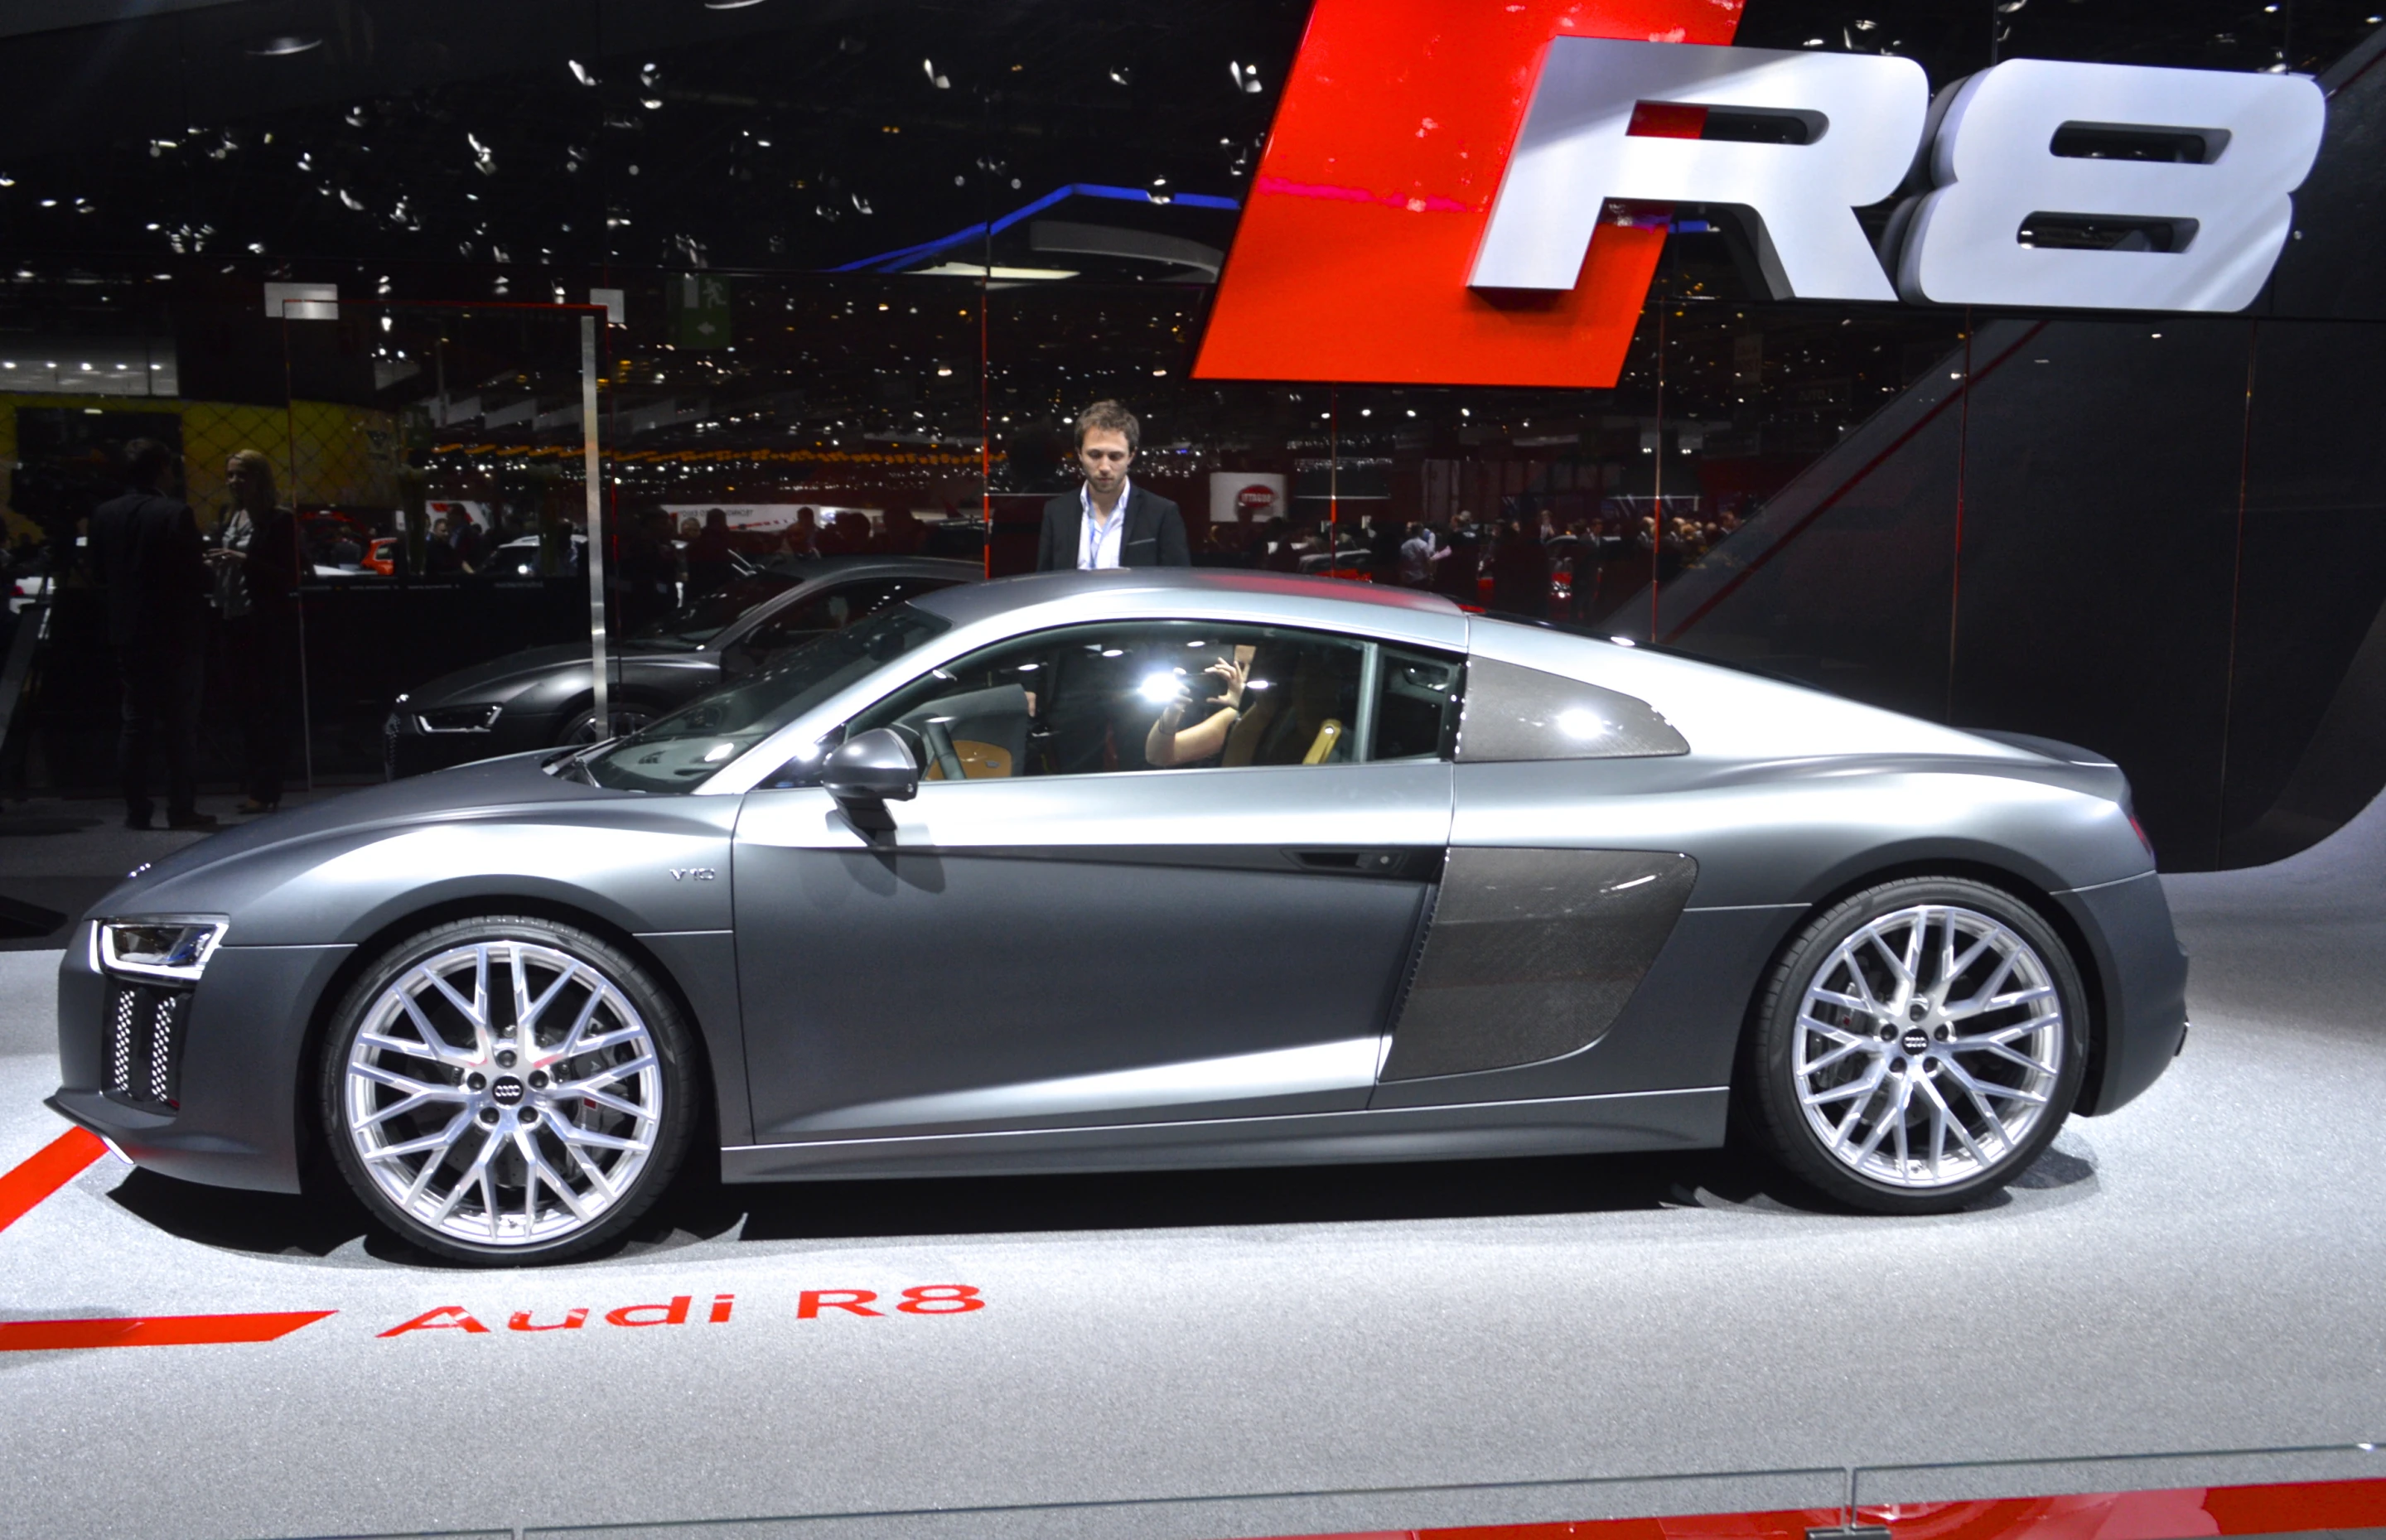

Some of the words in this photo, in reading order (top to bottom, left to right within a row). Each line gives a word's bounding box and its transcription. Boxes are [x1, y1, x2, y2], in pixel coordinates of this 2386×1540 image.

[1466, 35, 2326, 313] R8
[669, 867, 715, 881] V10
[374, 1294, 735, 1338] Audi
[797, 1284, 986, 1319] R8
